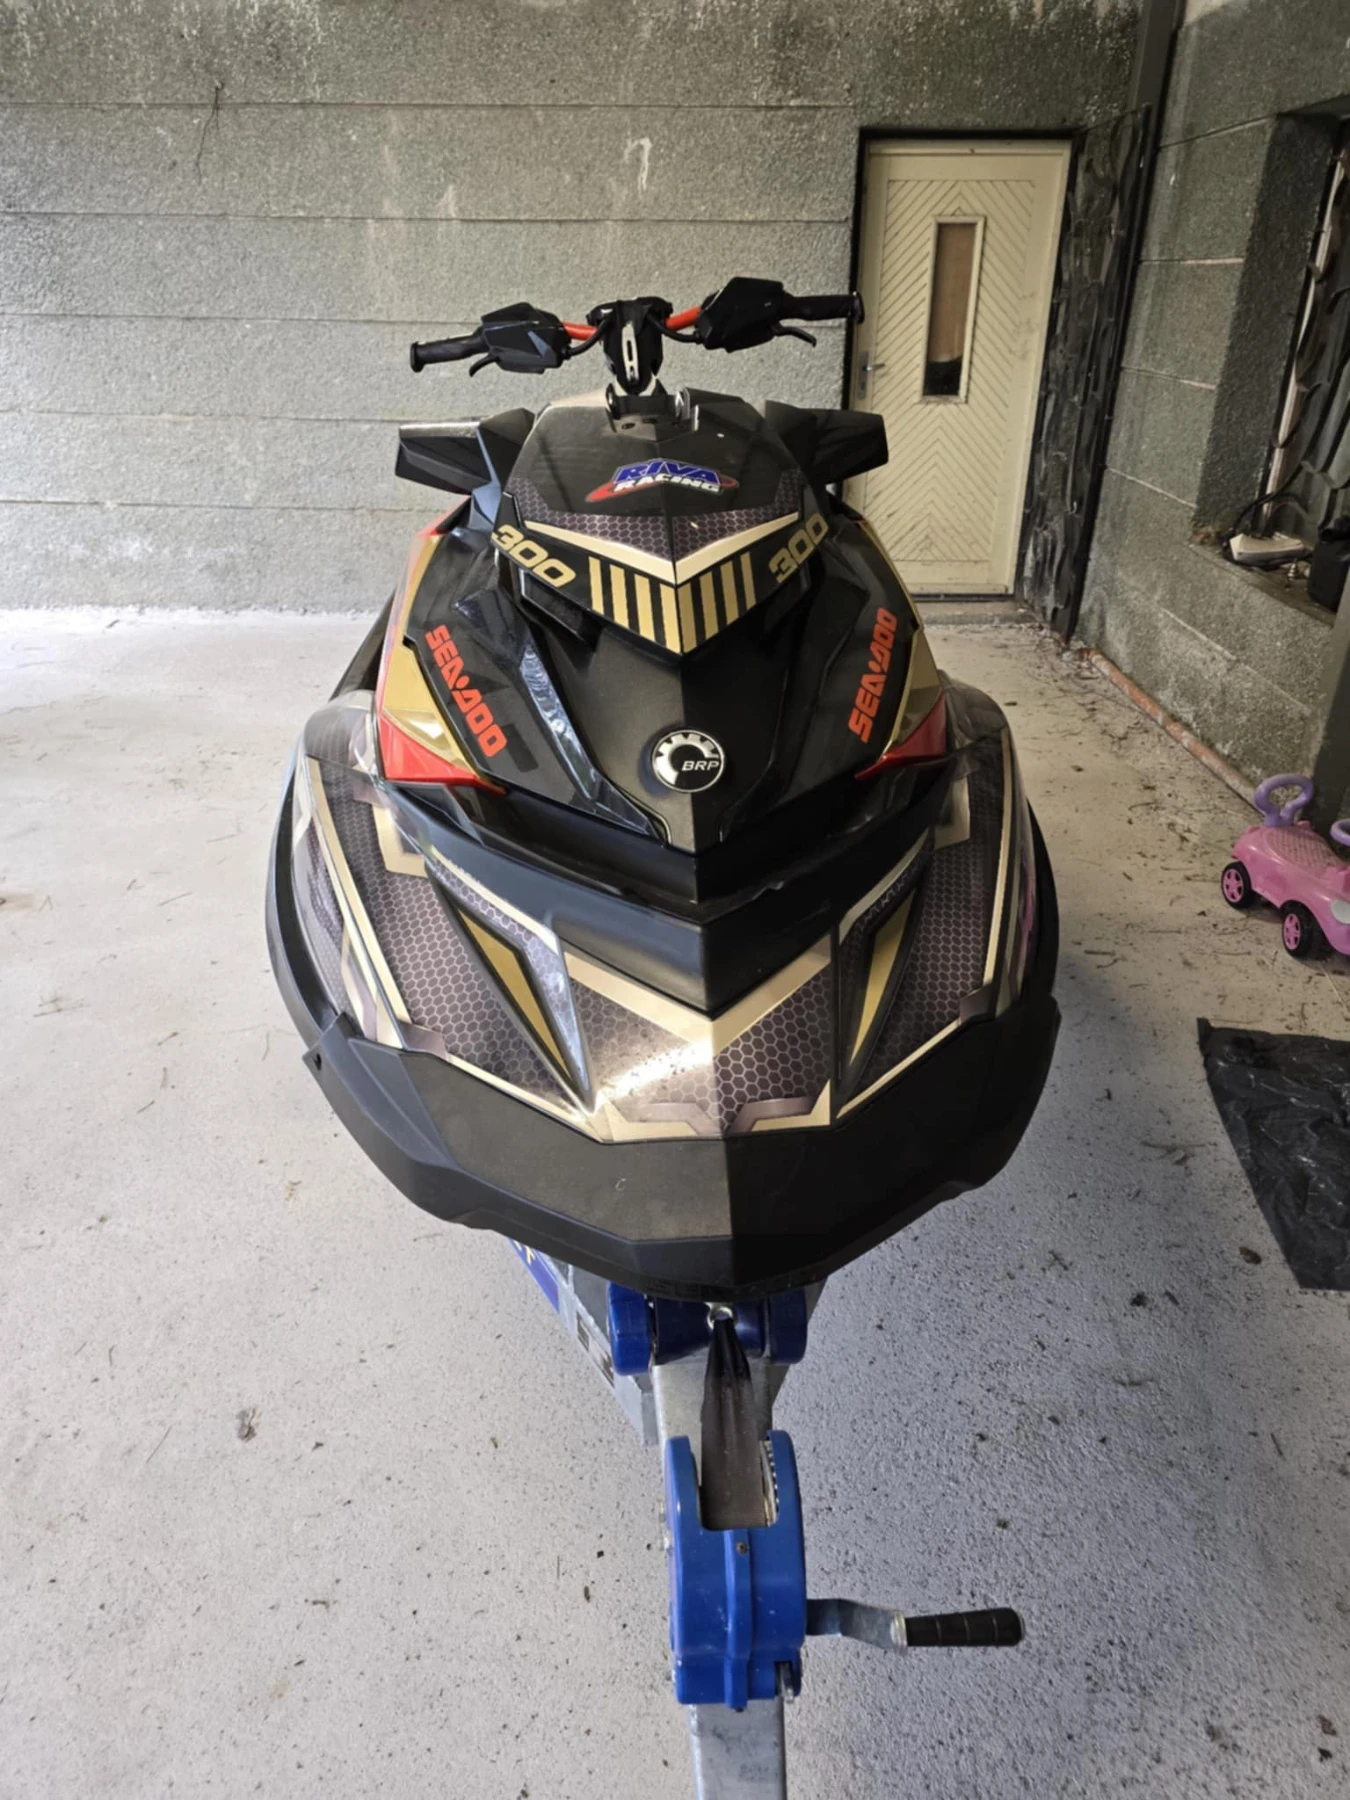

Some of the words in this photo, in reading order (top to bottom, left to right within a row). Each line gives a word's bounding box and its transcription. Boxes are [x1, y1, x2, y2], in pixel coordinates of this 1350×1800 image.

[613, 472, 720, 493] RACING
[614, 460, 721, 485] RIVA
[491, 523, 577, 588] 300
[768, 512, 829, 584] 300
[681, 760, 720, 772] BRP
